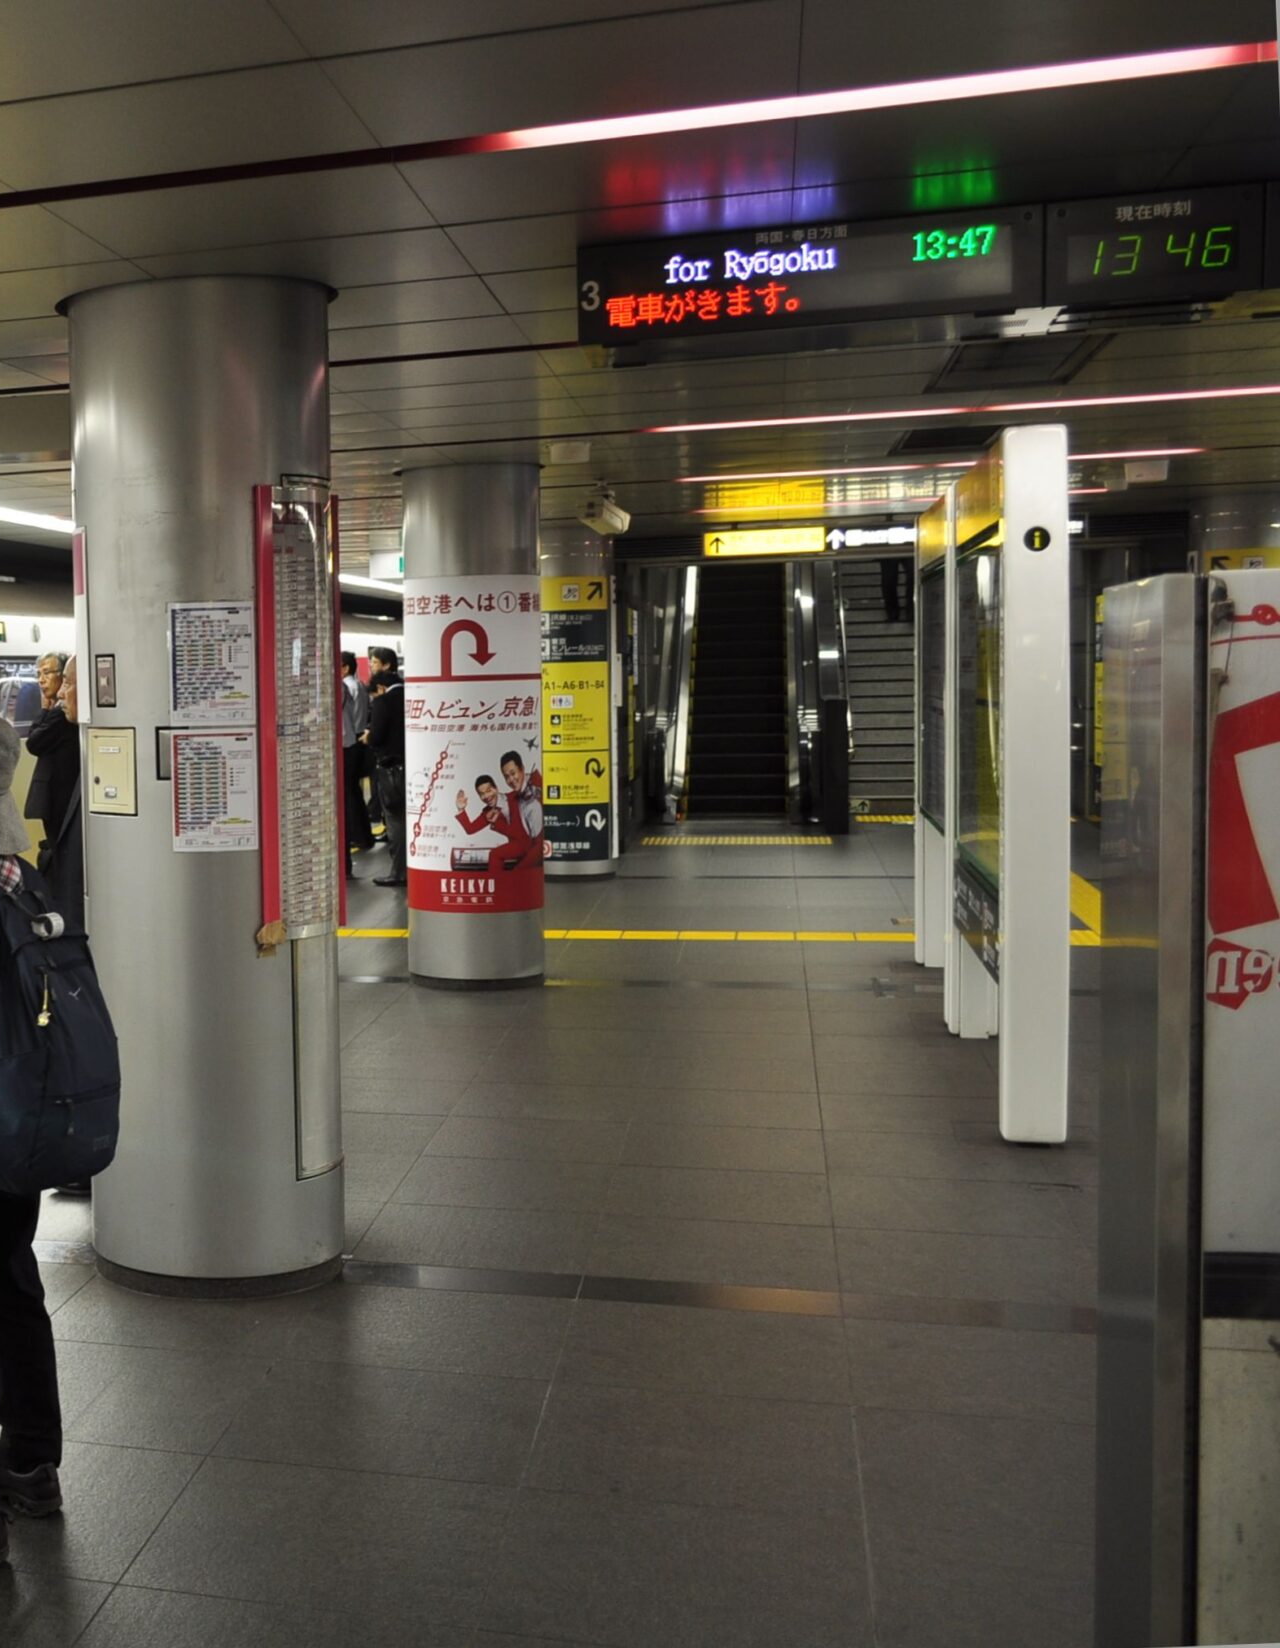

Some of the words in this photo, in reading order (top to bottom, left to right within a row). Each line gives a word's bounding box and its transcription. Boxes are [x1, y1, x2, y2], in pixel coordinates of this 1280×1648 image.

[1116, 201, 1191, 221] 現在時刻
[755, 225, 848, 244] 両国・春日方面
[913, 226, 996, 261] 13:47
[664, 256, 710, 283] for
[724, 243, 836, 280] Ryōgoku
[581, 281, 600, 311] 3
[606, 282, 800, 327] 電車がきます。
[441, 878, 495, 893] KEIKYU
